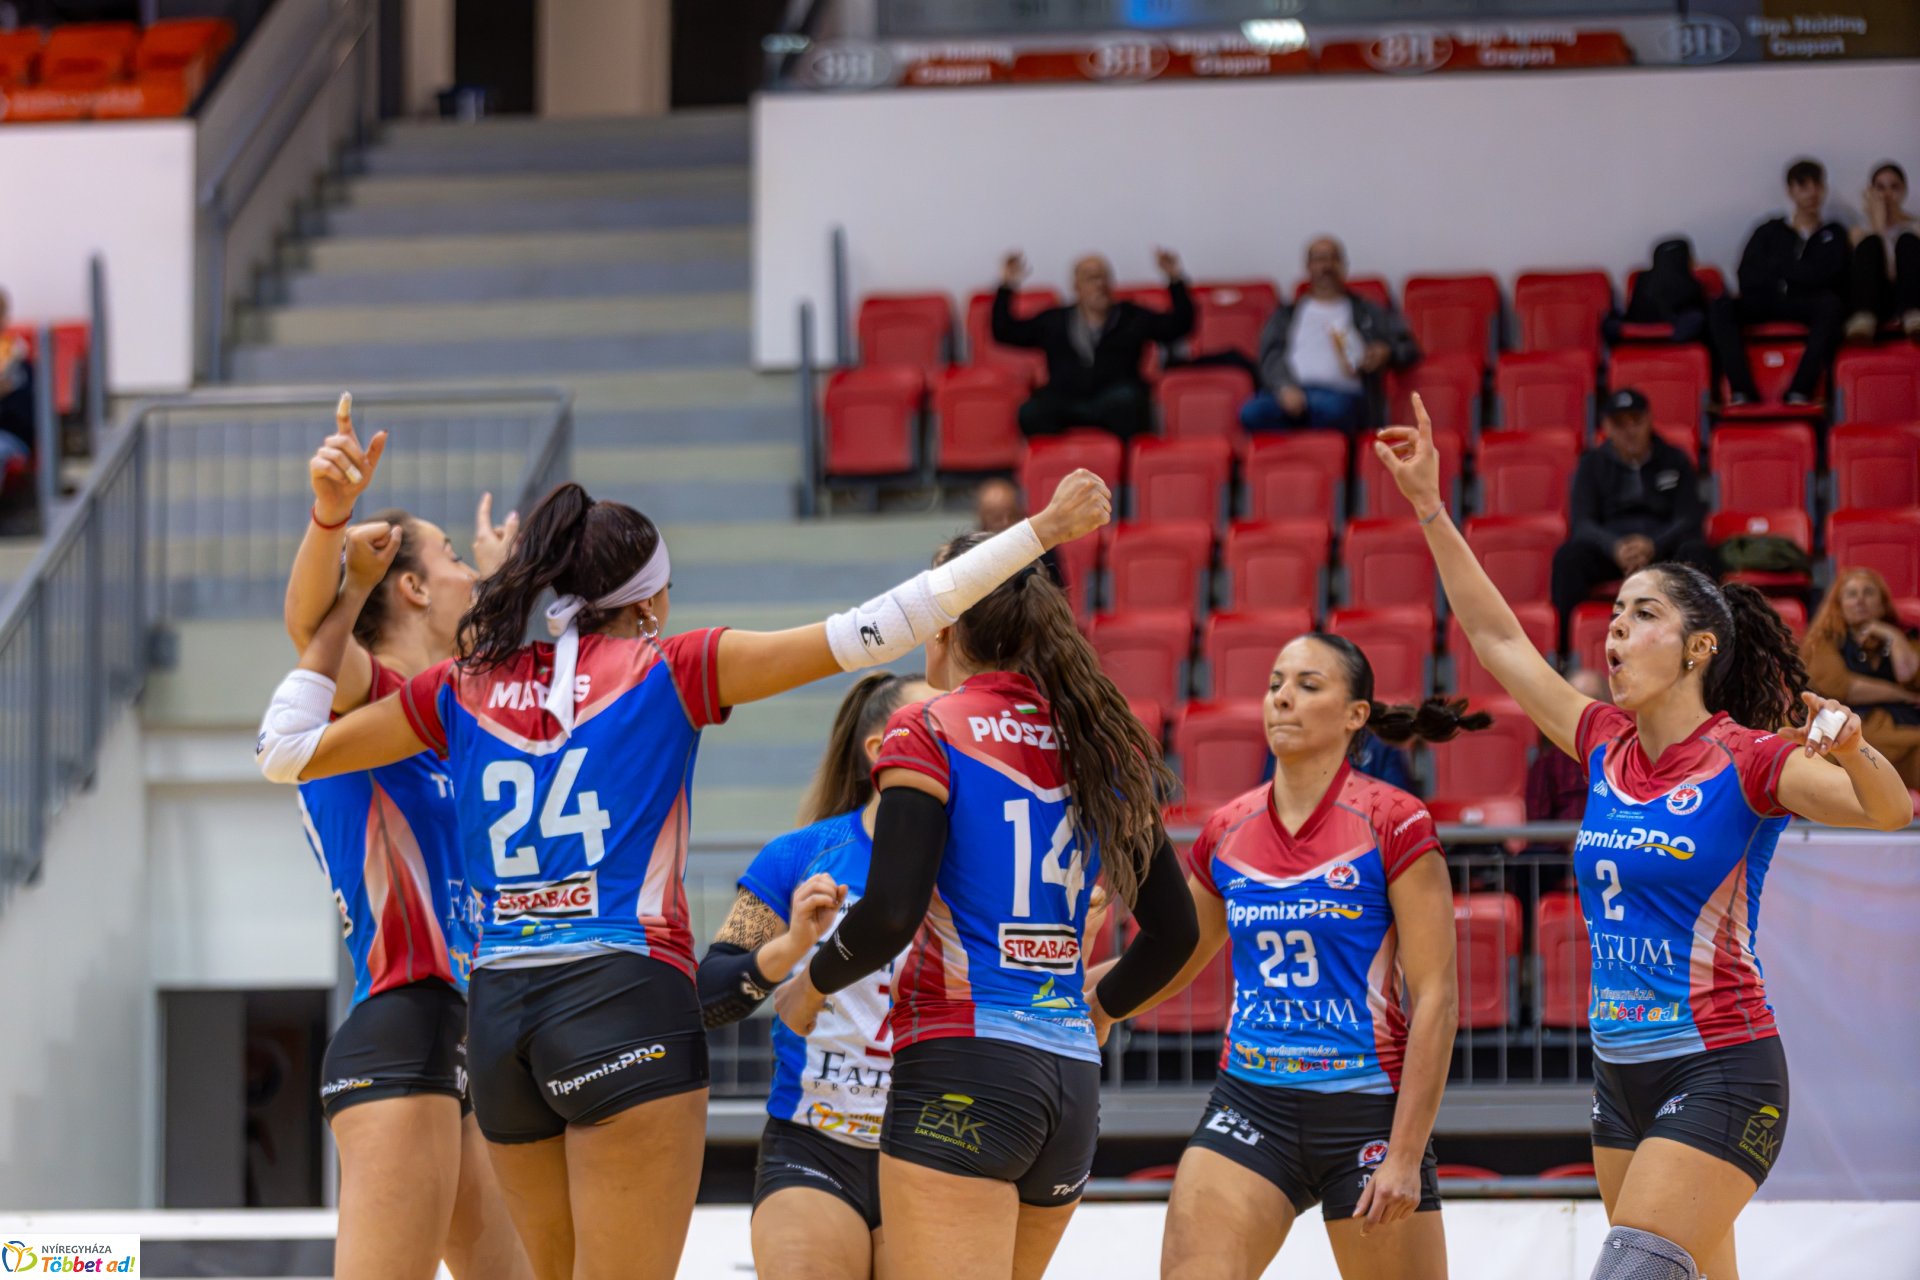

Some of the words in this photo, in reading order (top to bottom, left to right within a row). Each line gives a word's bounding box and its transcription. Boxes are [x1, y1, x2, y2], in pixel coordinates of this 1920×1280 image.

[489, 674, 592, 711] MATS
[968, 710, 1069, 751] PIÓSZ
[482, 747, 611, 878] 24
[1004, 798, 1086, 921] 14
[497, 886, 592, 911] STRABAG
[1596, 859, 1625, 922] 2
[1226, 898, 1364, 928] TippmixPRO
[1004, 939, 1079, 959] STRABAG
[1256, 930, 1320, 988] 23
[1592, 960, 1676, 976] OPERTY
[1241, 987, 1360, 1024] FATUM
[546, 1044, 667, 1096] TippmixPRO
[814, 1049, 891, 1090] FAT
[919, 1103, 987, 1146] EAK
[1743, 1118, 1780, 1162] EAK
